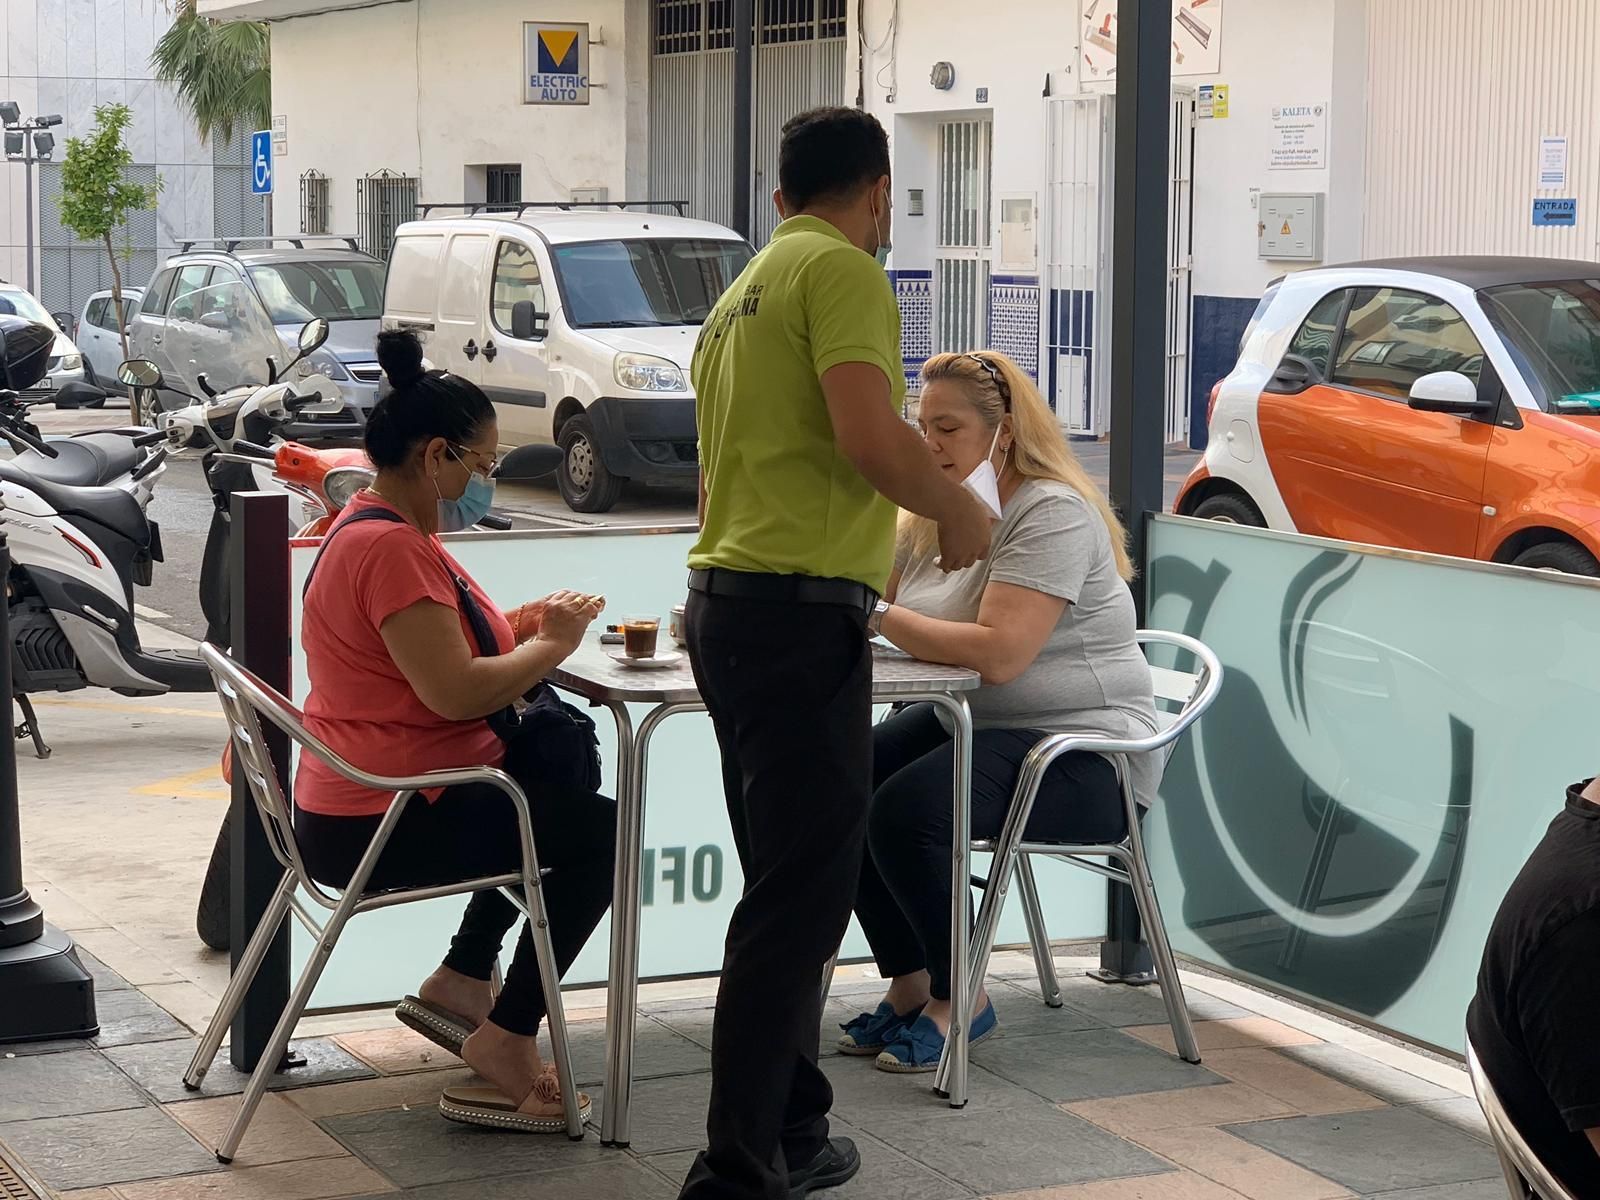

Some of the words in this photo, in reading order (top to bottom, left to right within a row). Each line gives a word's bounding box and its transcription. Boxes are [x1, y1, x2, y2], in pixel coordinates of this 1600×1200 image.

[530, 75, 587, 88] ELECTRIC
[541, 88, 577, 101] AUTO
[1282, 107, 1311, 116] KALETA
[1534, 202, 1575, 210] ENTRADA
[744, 285, 764, 296] BAR
